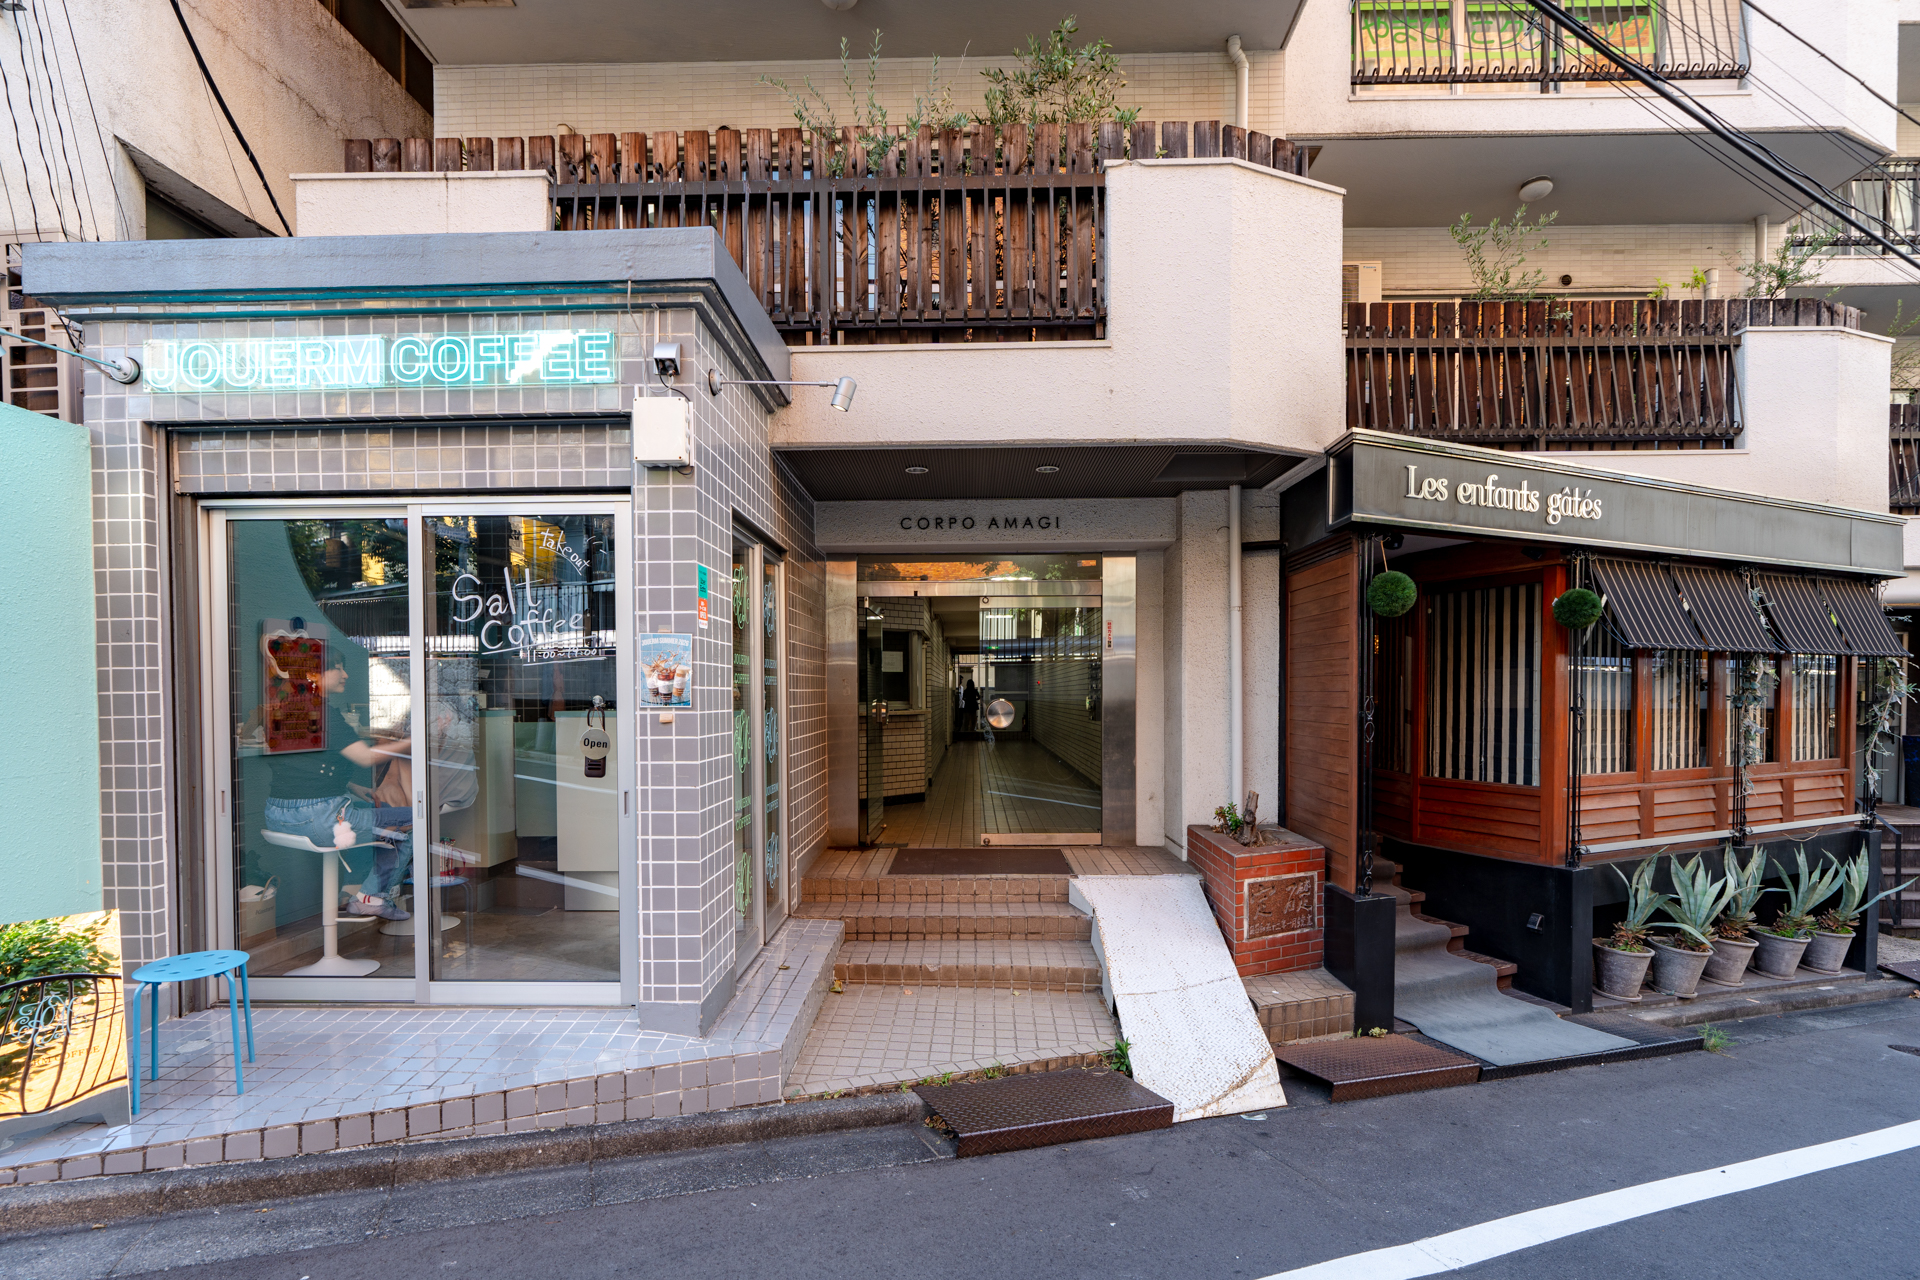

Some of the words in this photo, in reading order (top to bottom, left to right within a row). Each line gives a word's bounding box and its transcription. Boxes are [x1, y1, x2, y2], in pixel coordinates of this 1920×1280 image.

[148, 337, 381, 389] JOUERM
[389, 332, 611, 383] COFFEE
[1405, 464, 1449, 502] Les
[1456, 474, 1541, 513] enfants
[1546, 486, 1602, 525] gâtés
[900, 516, 976, 531] CORPO
[987, 516, 1060, 531] AMAGI
[452, 566, 544, 623] Salt
[481, 608, 585, 650] Coffee
[583, 737, 608, 749] Open
